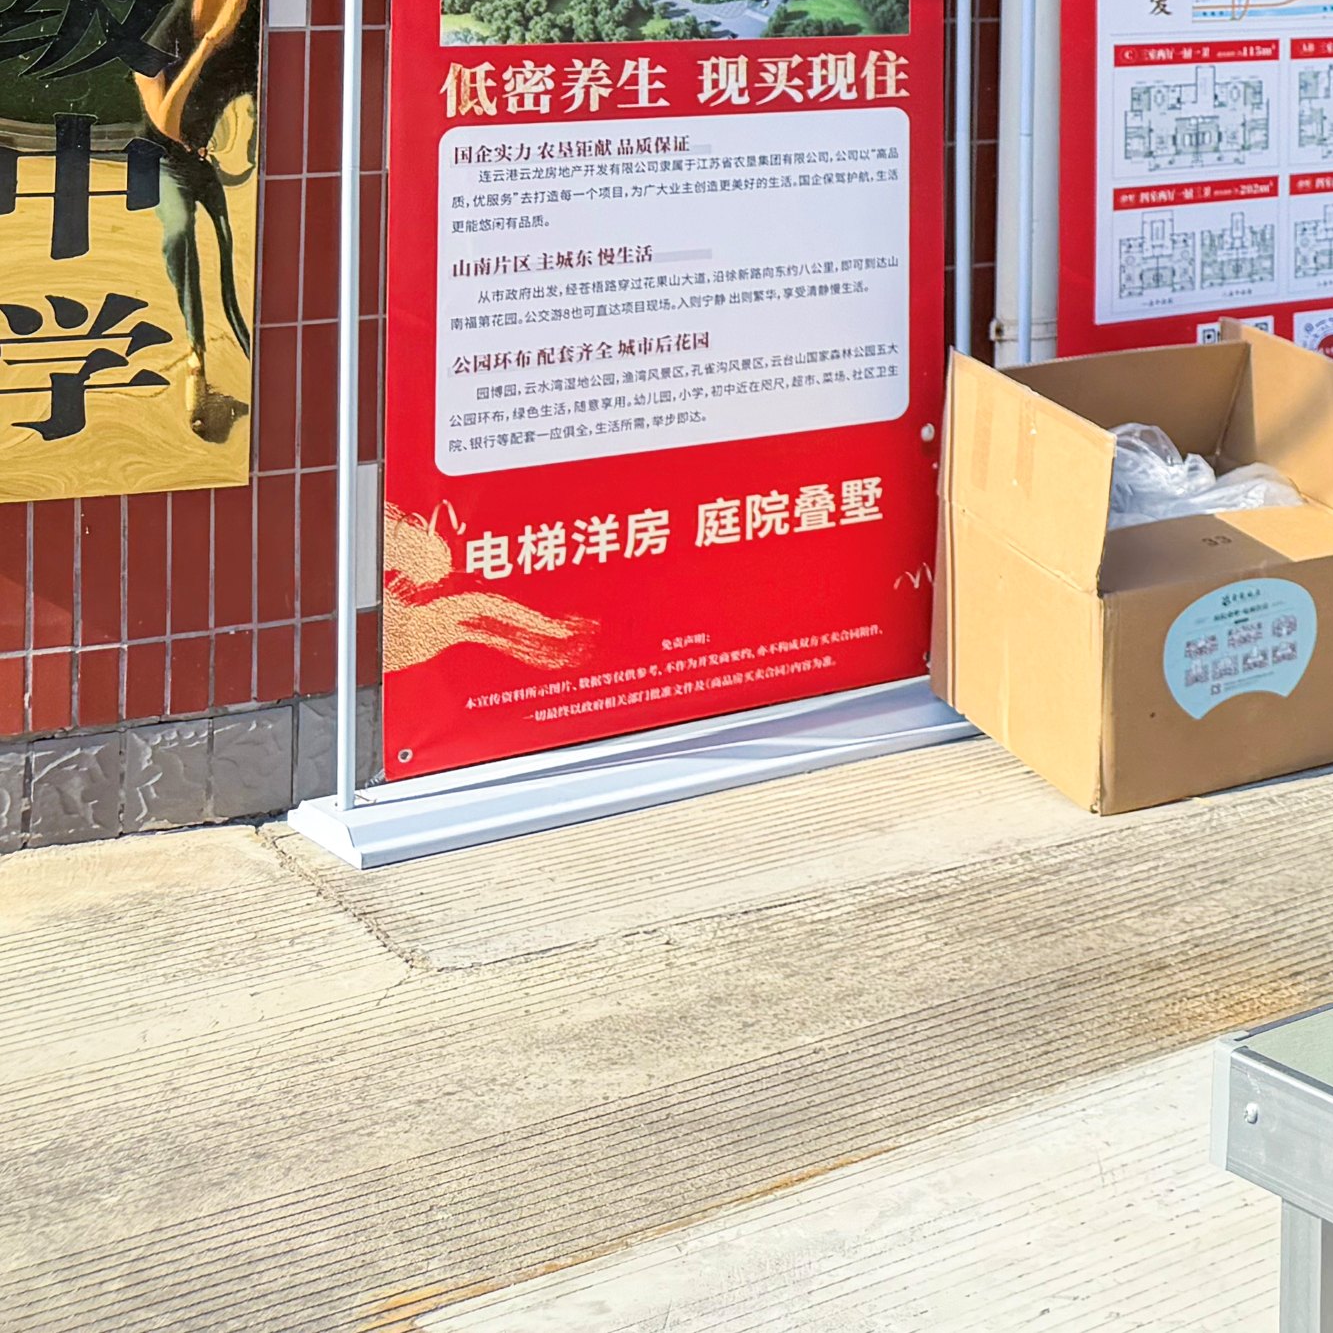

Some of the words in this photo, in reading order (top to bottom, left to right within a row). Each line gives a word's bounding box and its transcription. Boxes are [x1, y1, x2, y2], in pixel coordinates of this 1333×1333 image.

[440, 56, 670, 118] 低密养生
[697, 49, 910, 107] 现买现住
[454, 142, 531, 165] 国企实力
[538, 139, 612, 160] 农垦钜献
[617, 134, 690, 156] 品质保证
[452, 254, 531, 278] 山南片区
[537, 249, 593, 271] 主城东
[597, 242, 653, 267] 慢生活
[452, 350, 532, 375] 公园环布
[537, 341, 613, 366] 配套齐全
[618, 332, 709, 357] 城市后花园
[465, 508, 671, 581] 电梯洋房
[695, 476, 883, 547] 庭院叠墅
